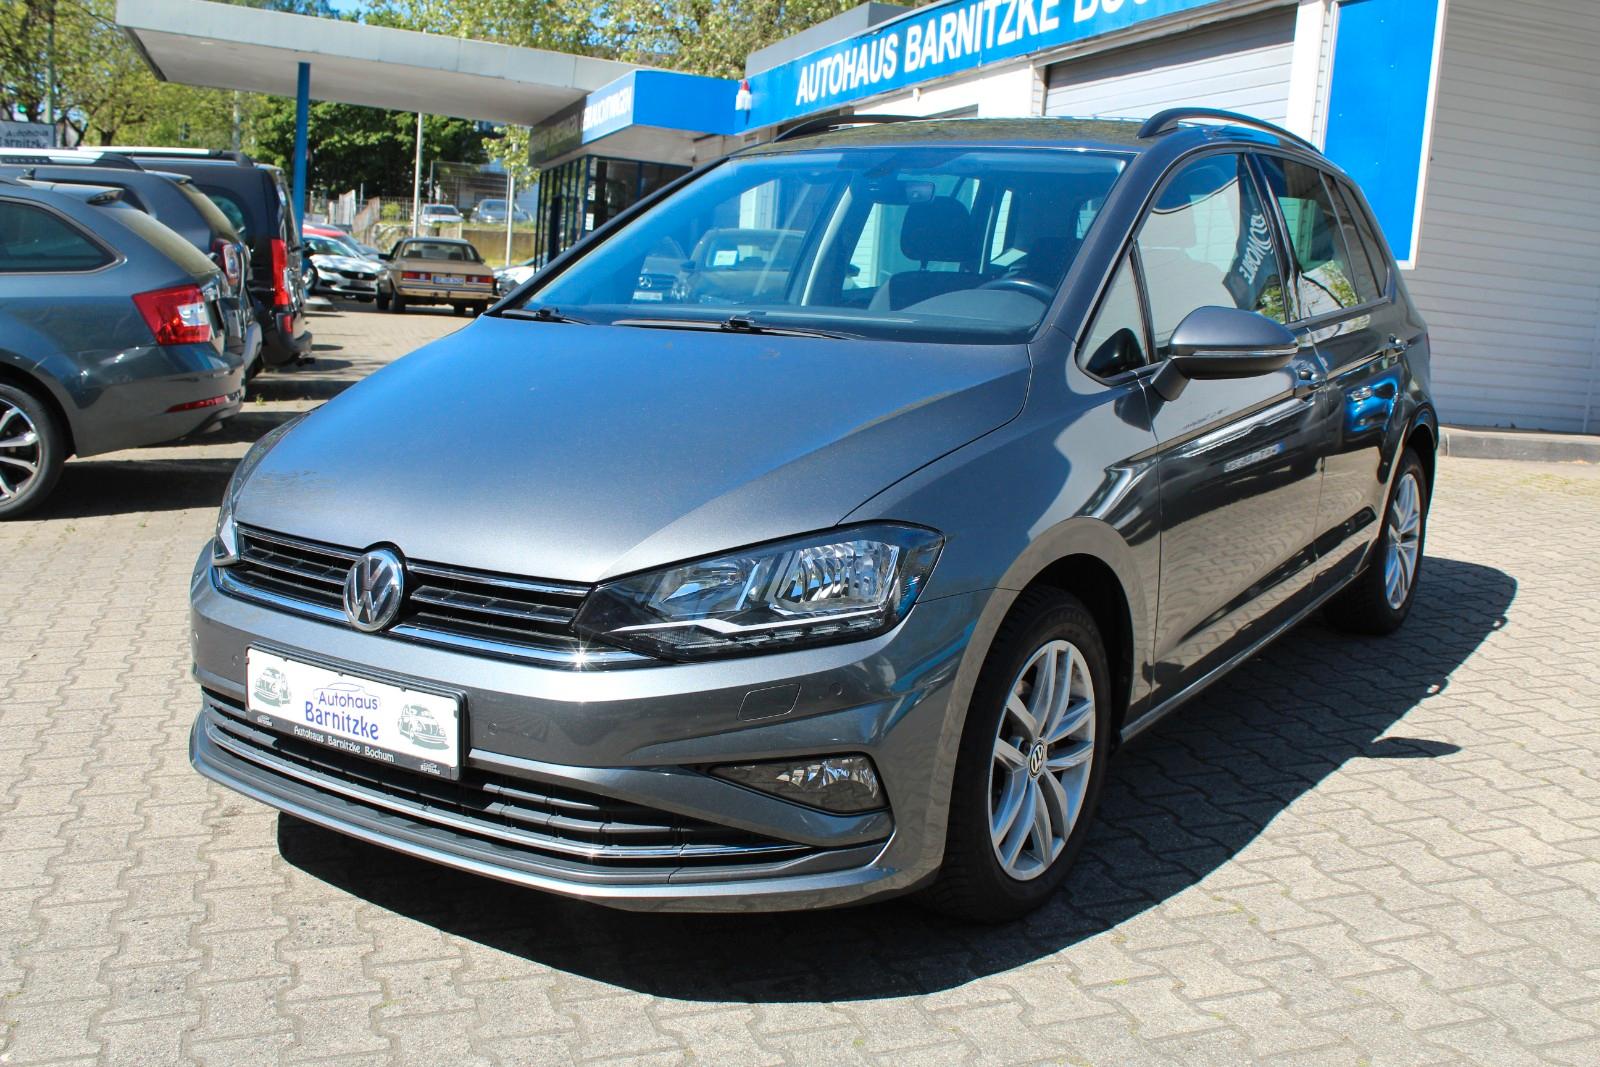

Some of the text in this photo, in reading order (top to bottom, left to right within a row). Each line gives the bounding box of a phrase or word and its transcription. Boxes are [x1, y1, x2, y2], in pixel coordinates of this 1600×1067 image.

[795, 0, 1061, 106] AUTOHAUS BARNITZKE
[343, 548, 404, 632] VW
[305, 700, 379, 740] Barnitzke
[318, 691, 378, 710] Autohaus
[293, 725, 394, 763] Autohaus Barnitzke Bochum
